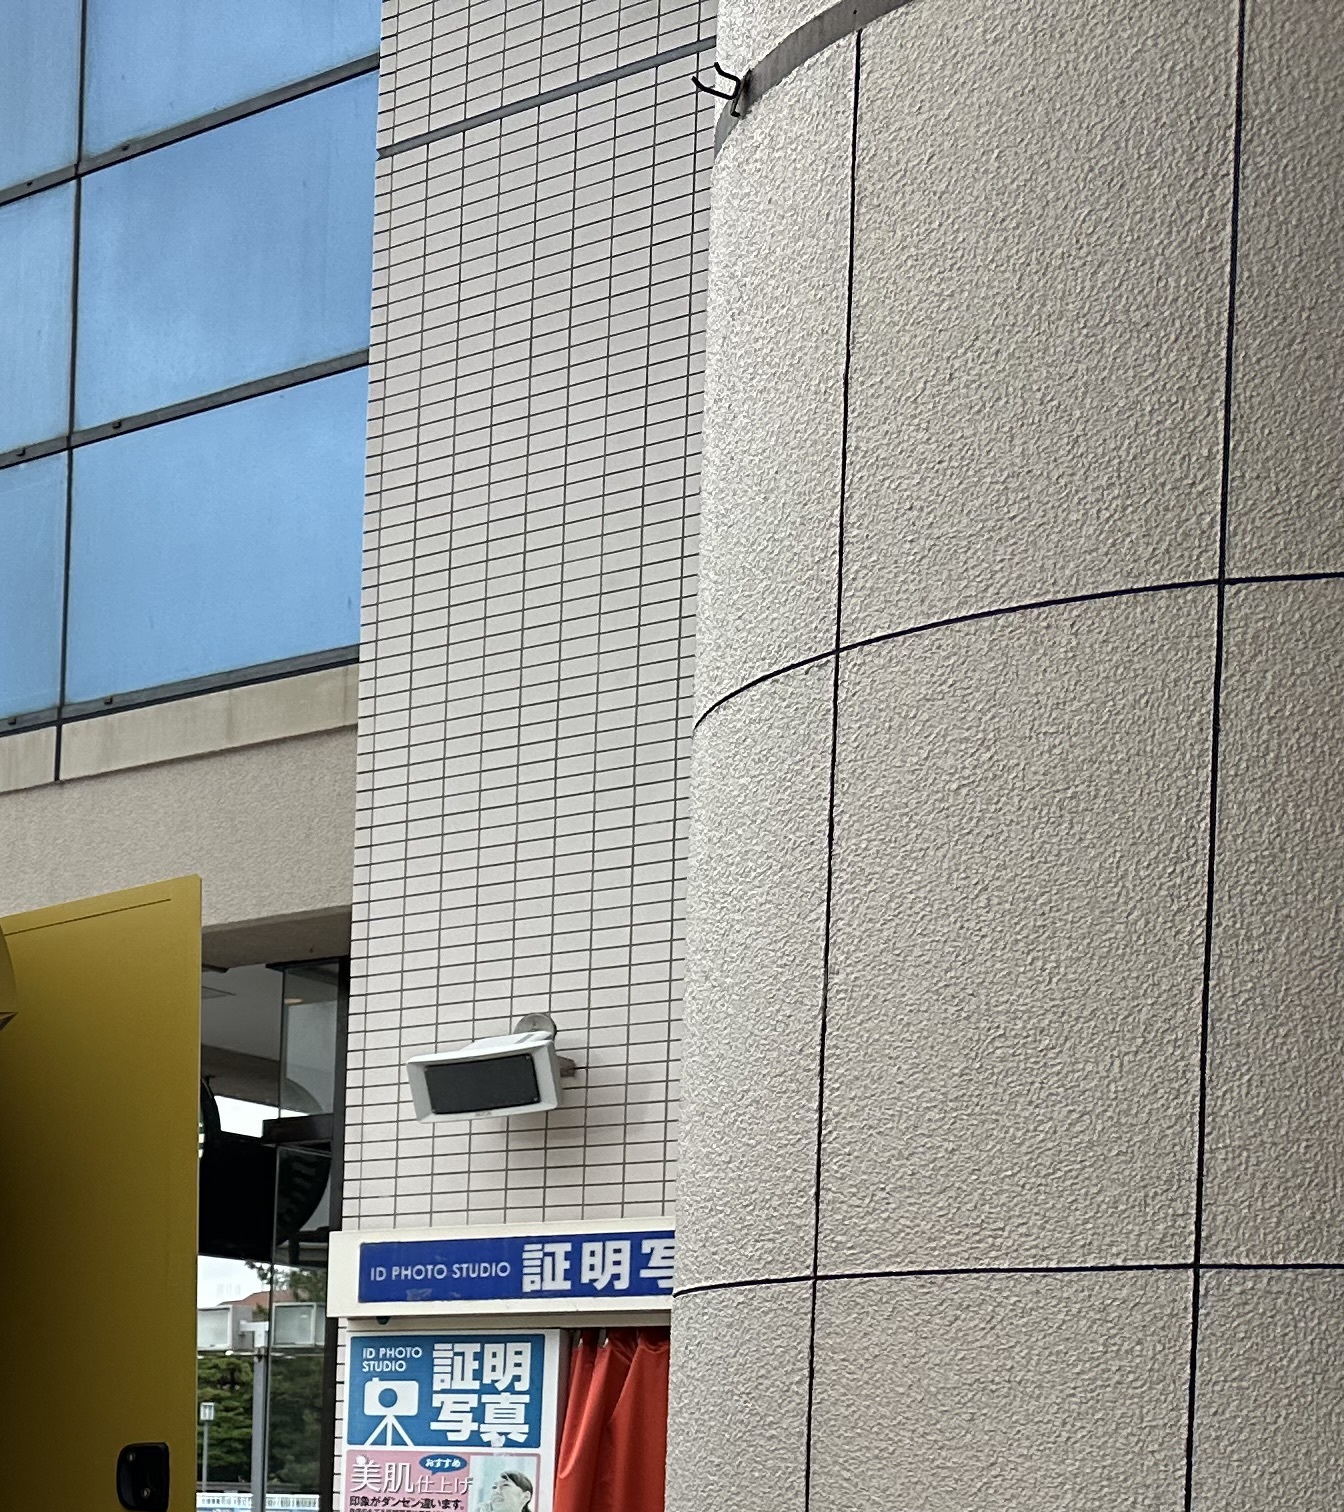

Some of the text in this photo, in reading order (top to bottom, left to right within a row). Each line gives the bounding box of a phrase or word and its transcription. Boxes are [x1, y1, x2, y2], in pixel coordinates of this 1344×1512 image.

[370, 1261, 511, 1281] ID PHOTO STUDIO
[363, 1347, 423, 1359] ID PHOTO
[362, 1360, 407, 1373] STUDIO
[433, 1342, 532, 1391] 証明
[430, 1392, 530, 1445] 写真
[424, 1458, 461, 1469] おすすめ
[350, 1458, 474, 1495] 美肌仕上げ
